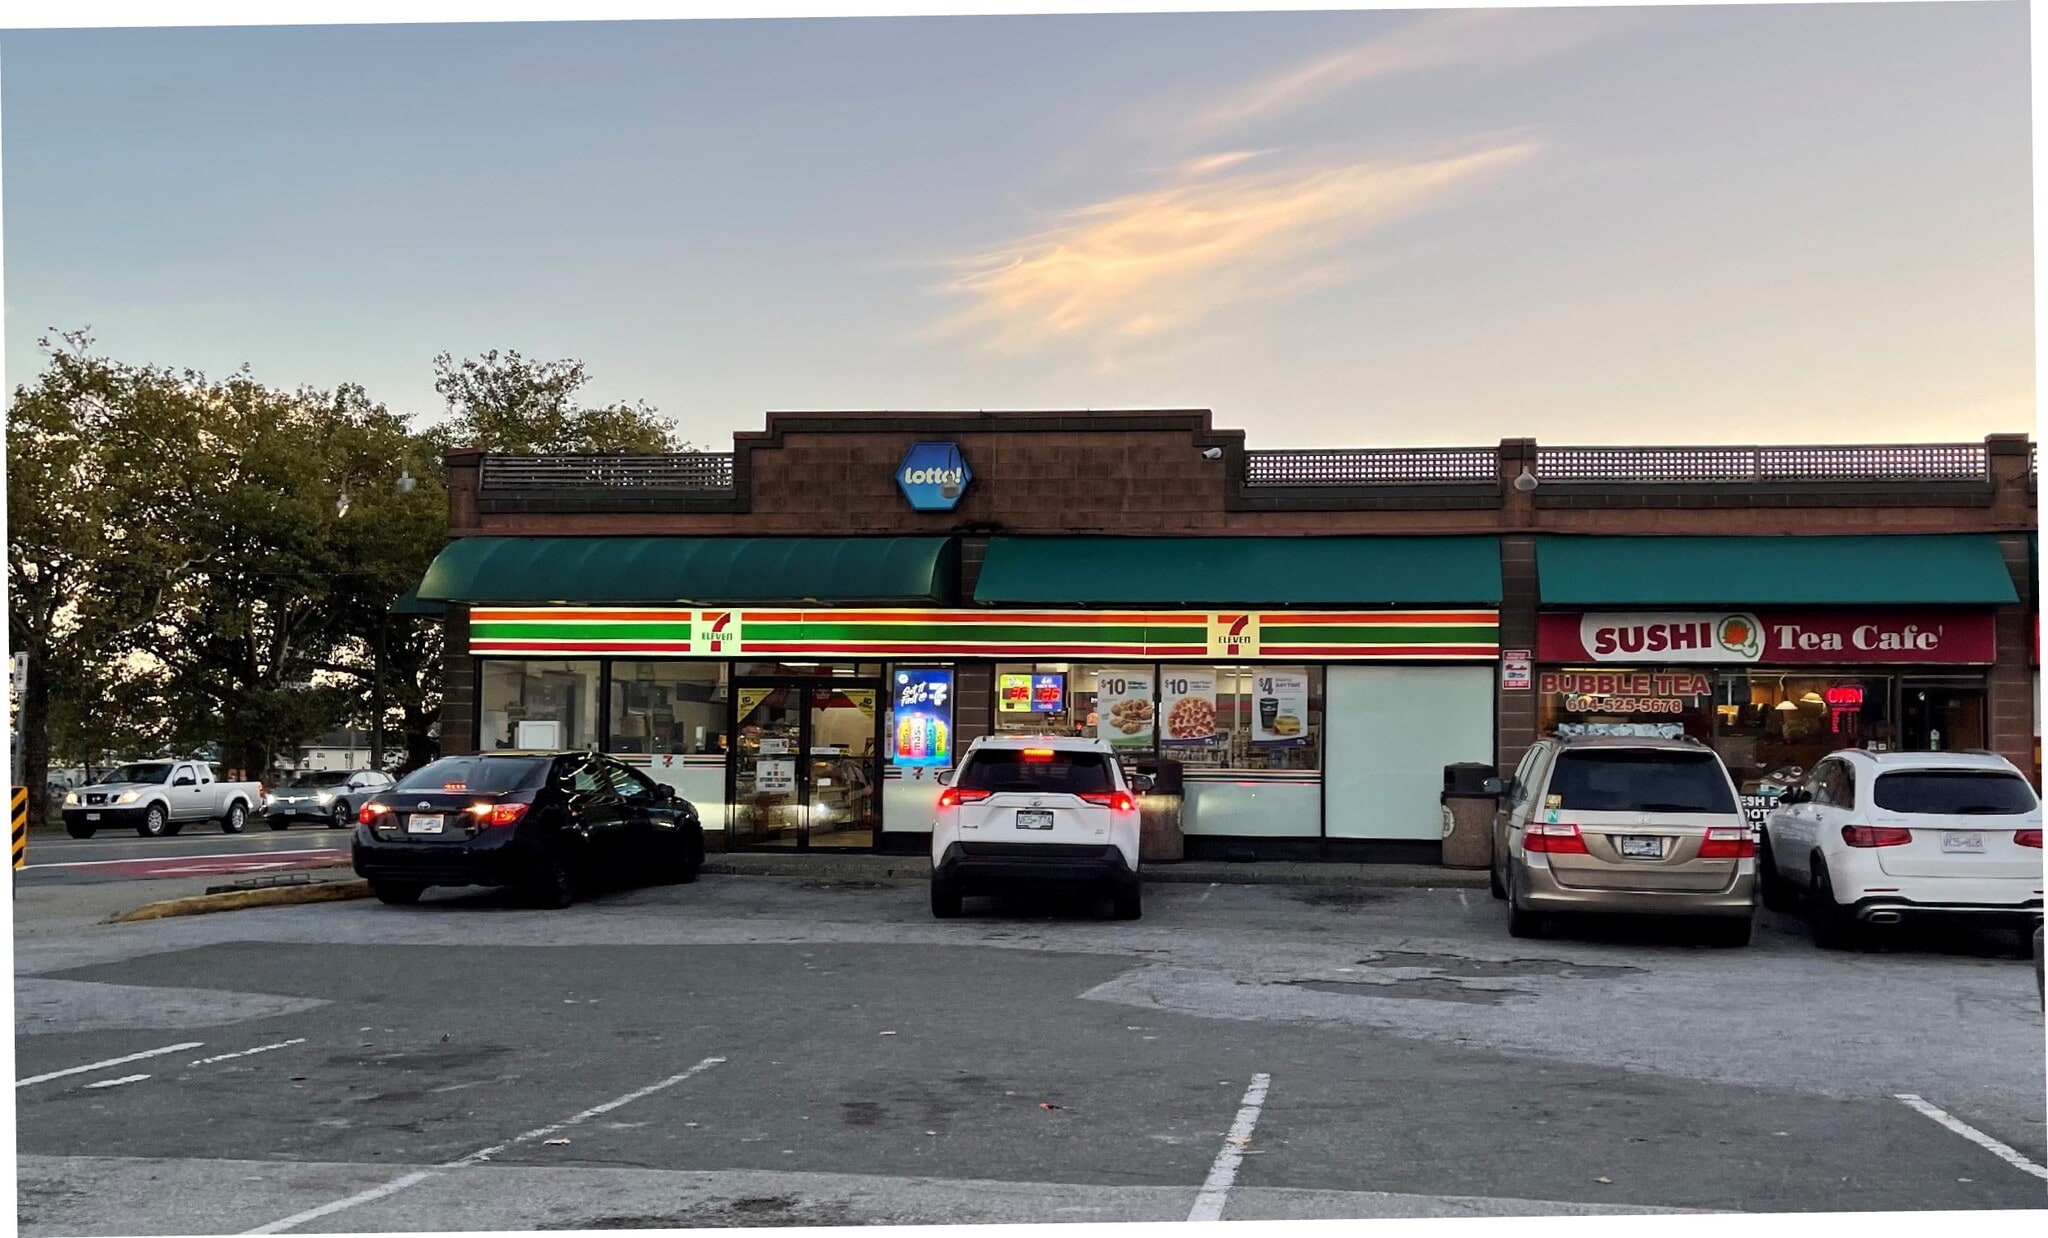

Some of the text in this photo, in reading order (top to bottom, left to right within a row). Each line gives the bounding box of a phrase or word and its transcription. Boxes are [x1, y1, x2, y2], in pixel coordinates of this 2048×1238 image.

[905, 467, 962, 484] lotto!
[1595, 622, 1712, 655] SUSHI
[1773, 625, 1844, 650] Tea
[1101, 678, 1127, 695] $10
[1164, 678, 1188, 695] $10
[1540, 673, 1712, 696] BUBBLE TEA
[1566, 697, 1683, 713] 604-525-5678
